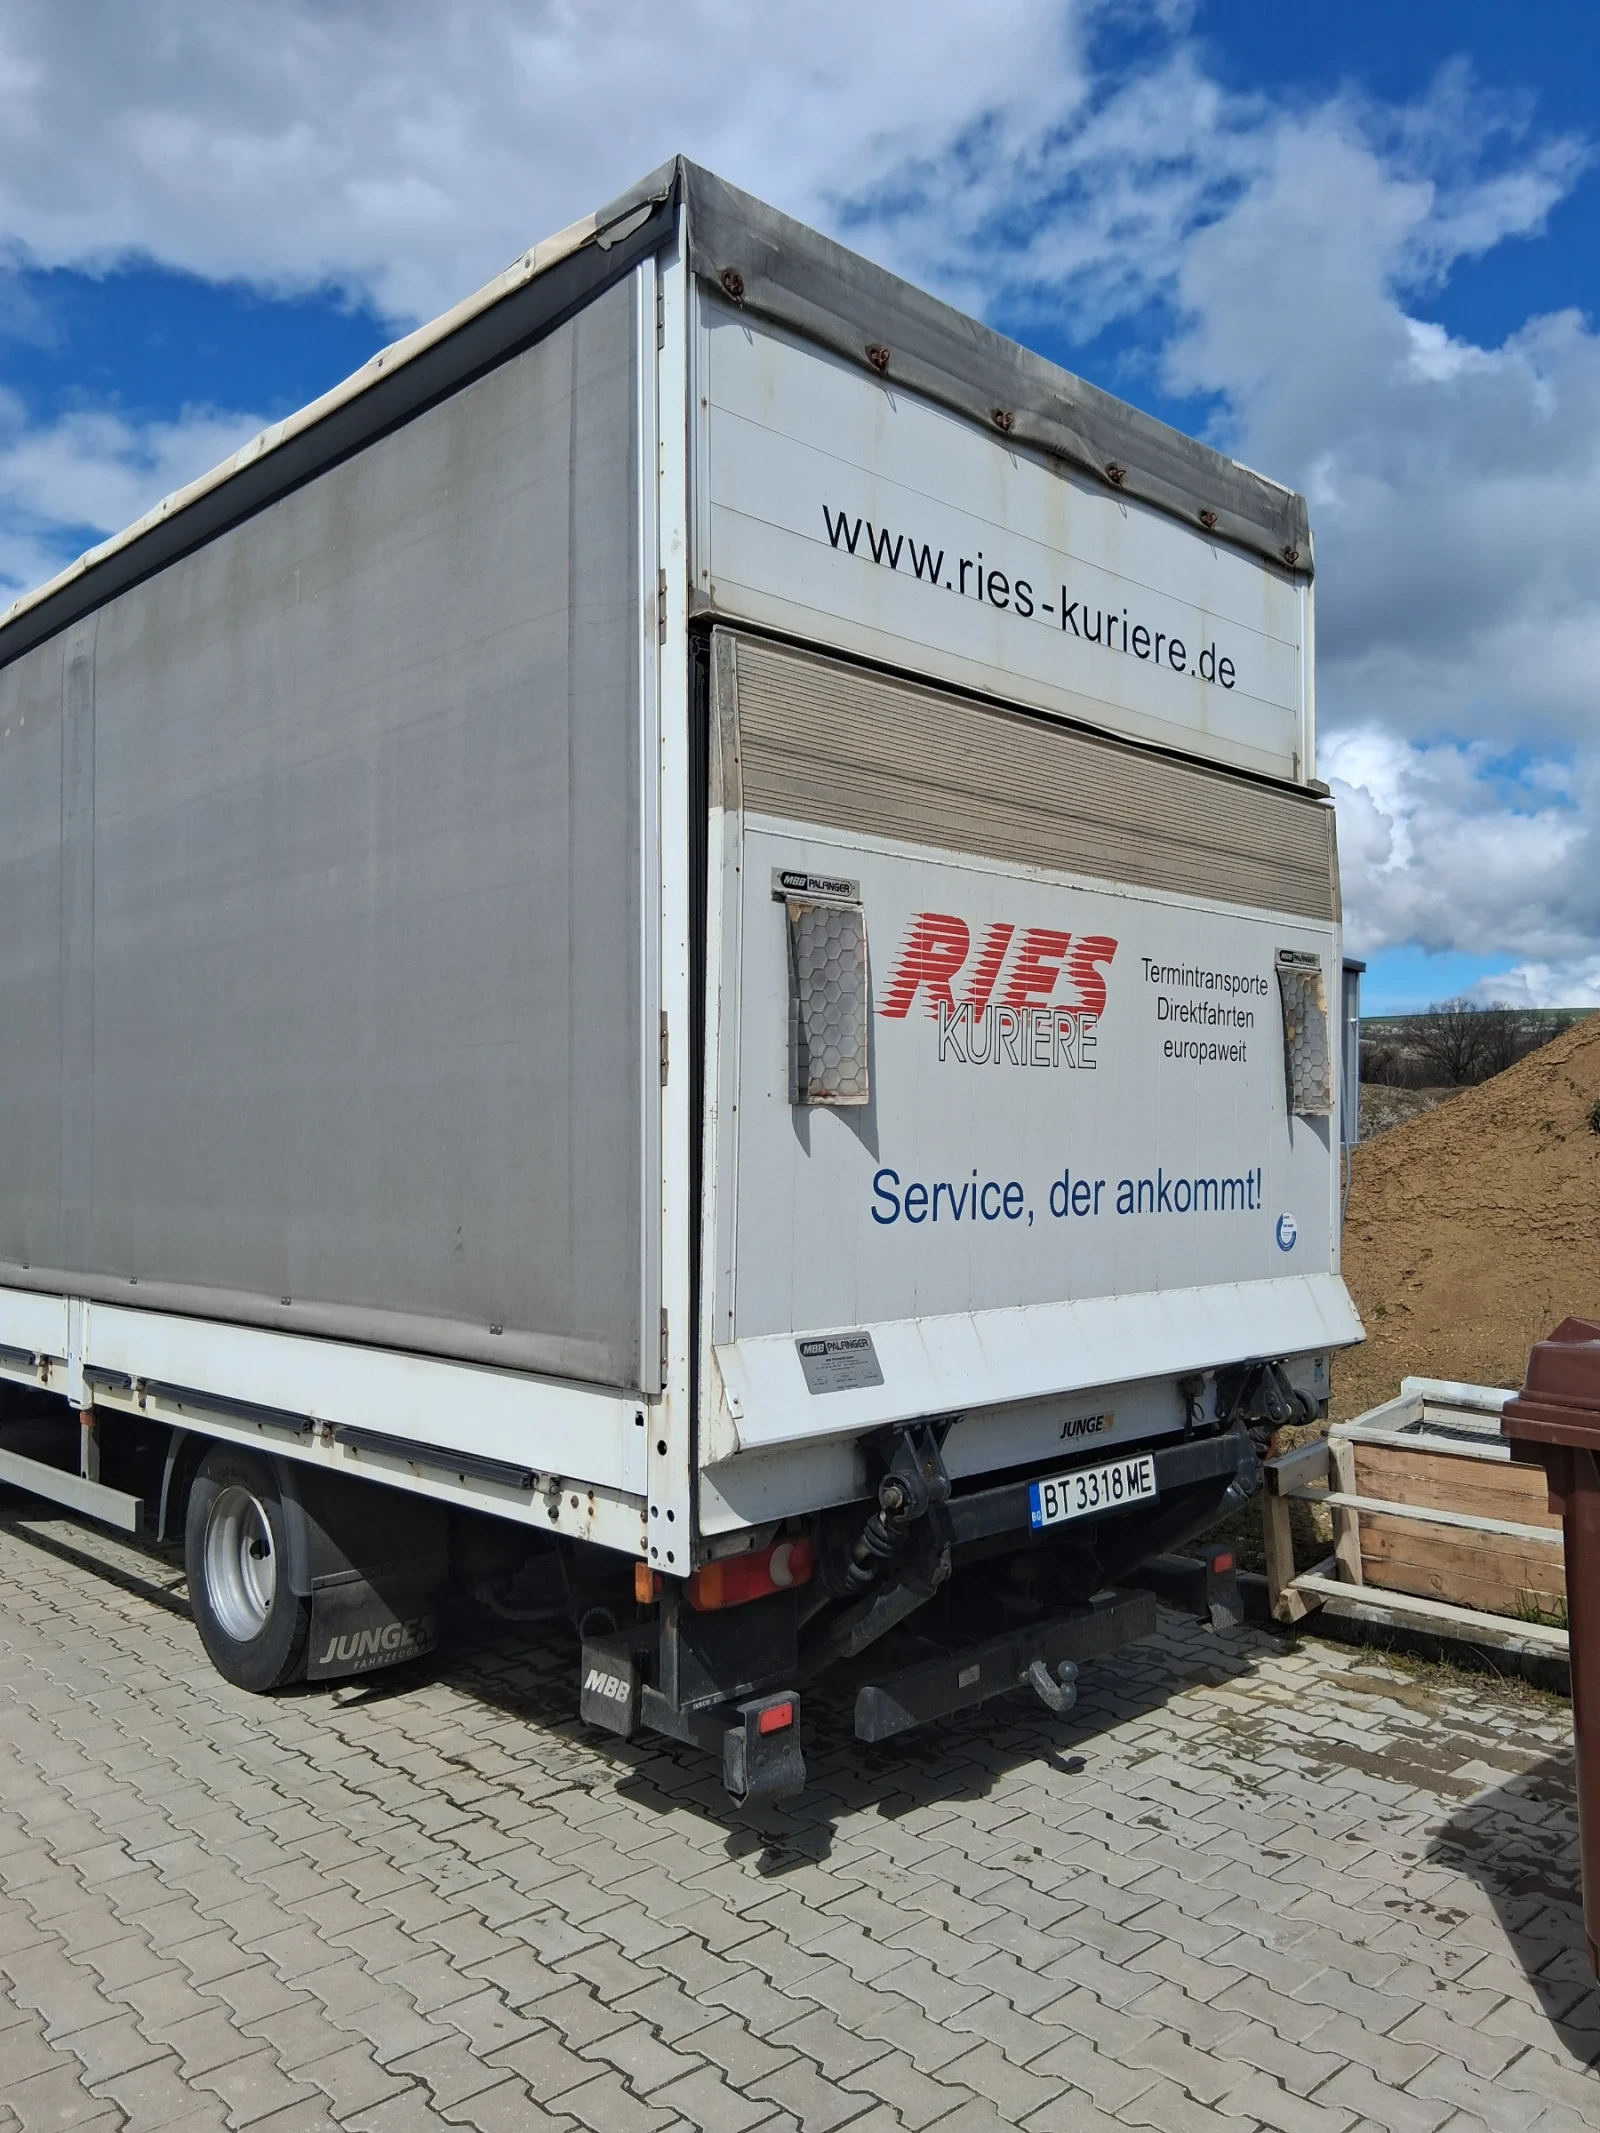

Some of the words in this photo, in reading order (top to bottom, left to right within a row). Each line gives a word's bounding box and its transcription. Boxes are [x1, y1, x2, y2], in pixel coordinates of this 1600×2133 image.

[822, 503, 1237, 689] www.ries-kuriere.de
[871, 911, 1119, 1033] RIES
[1141, 957, 1269, 998] Termintransporte
[1157, 996, 1255, 1029] Direktfahrten
[938, 999, 1099, 1070] KURIERE
[1163, 1038, 1247, 1066] europaweit
[870, 1168, 1035, 1228] Service,
[1049, 1168, 1106, 1218] der
[1115, 1167, 1263, 1216] ankommt!
[1060, 1414, 1105, 1440] JUNGE
[1031, 1511, 1042, 1522] BG
[318, 1617, 420, 1664] JUNGE
[353, 1641, 432, 1670] FAHRZEUGB
[584, 1668, 631, 1704] MBB
